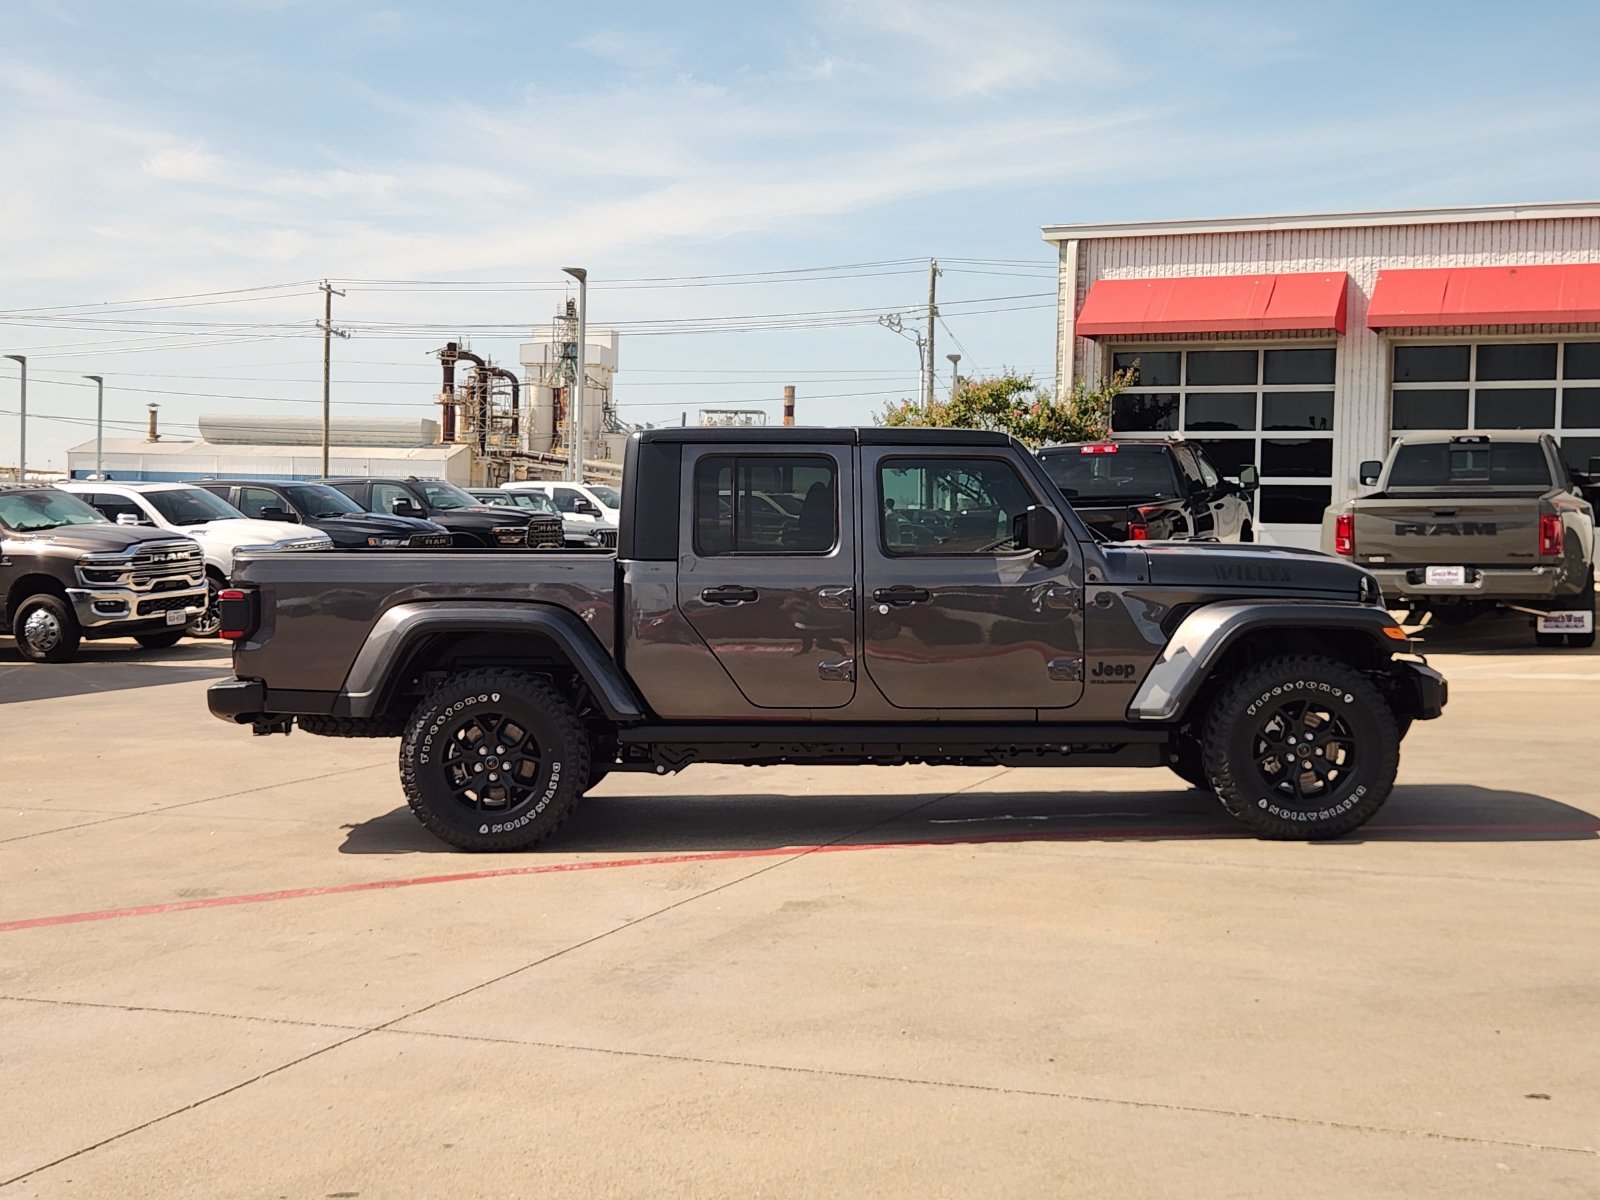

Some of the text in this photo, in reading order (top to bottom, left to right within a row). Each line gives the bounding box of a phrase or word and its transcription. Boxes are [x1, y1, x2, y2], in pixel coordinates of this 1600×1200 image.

[1395, 523, 1497, 536] RAM
[153, 552, 191, 562] RAM
[1212, 563, 1291, 582] WILLYS
[1091, 661, 1136, 679] Jeep
[1247, 680, 1342, 716] Firestone
[419, 694, 489, 764] Firestone
[491, 762, 562, 834] DESTINATION
[1268, 785, 1367, 821] DESTINATION
